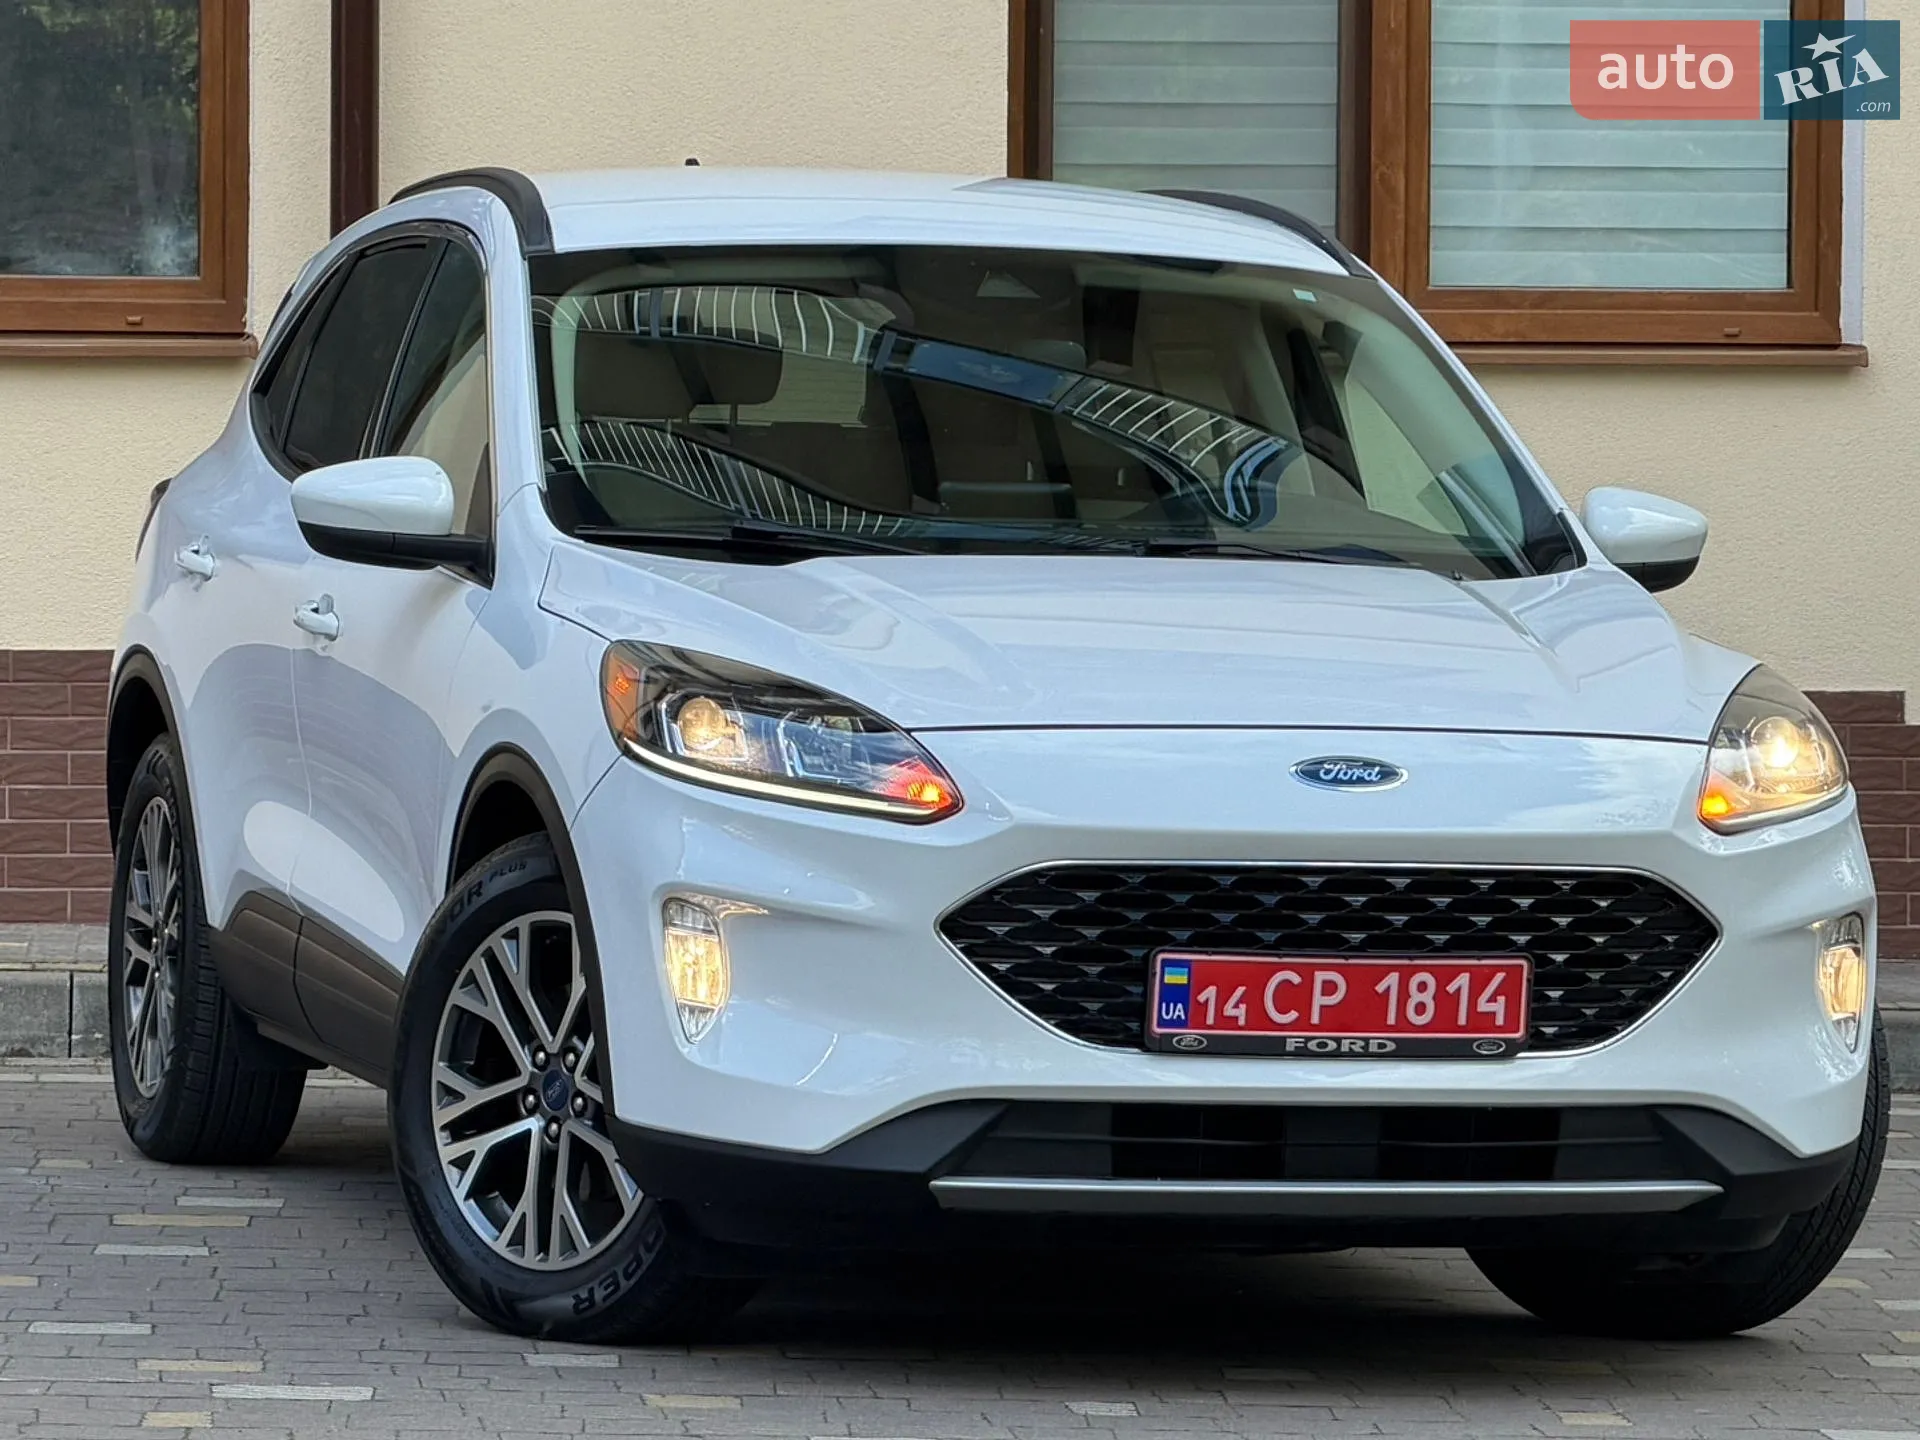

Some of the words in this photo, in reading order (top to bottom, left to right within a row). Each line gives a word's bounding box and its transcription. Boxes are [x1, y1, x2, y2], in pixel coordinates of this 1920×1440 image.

[1320, 760, 1382, 781] Ford
[1196, 985, 1248, 1027] 14
[1263, 970, 1348, 1025] CP
[1374, 971, 1507, 1027] 1814
[1161, 1002, 1186, 1020] UA
[1285, 1038, 1397, 1053] FORD
